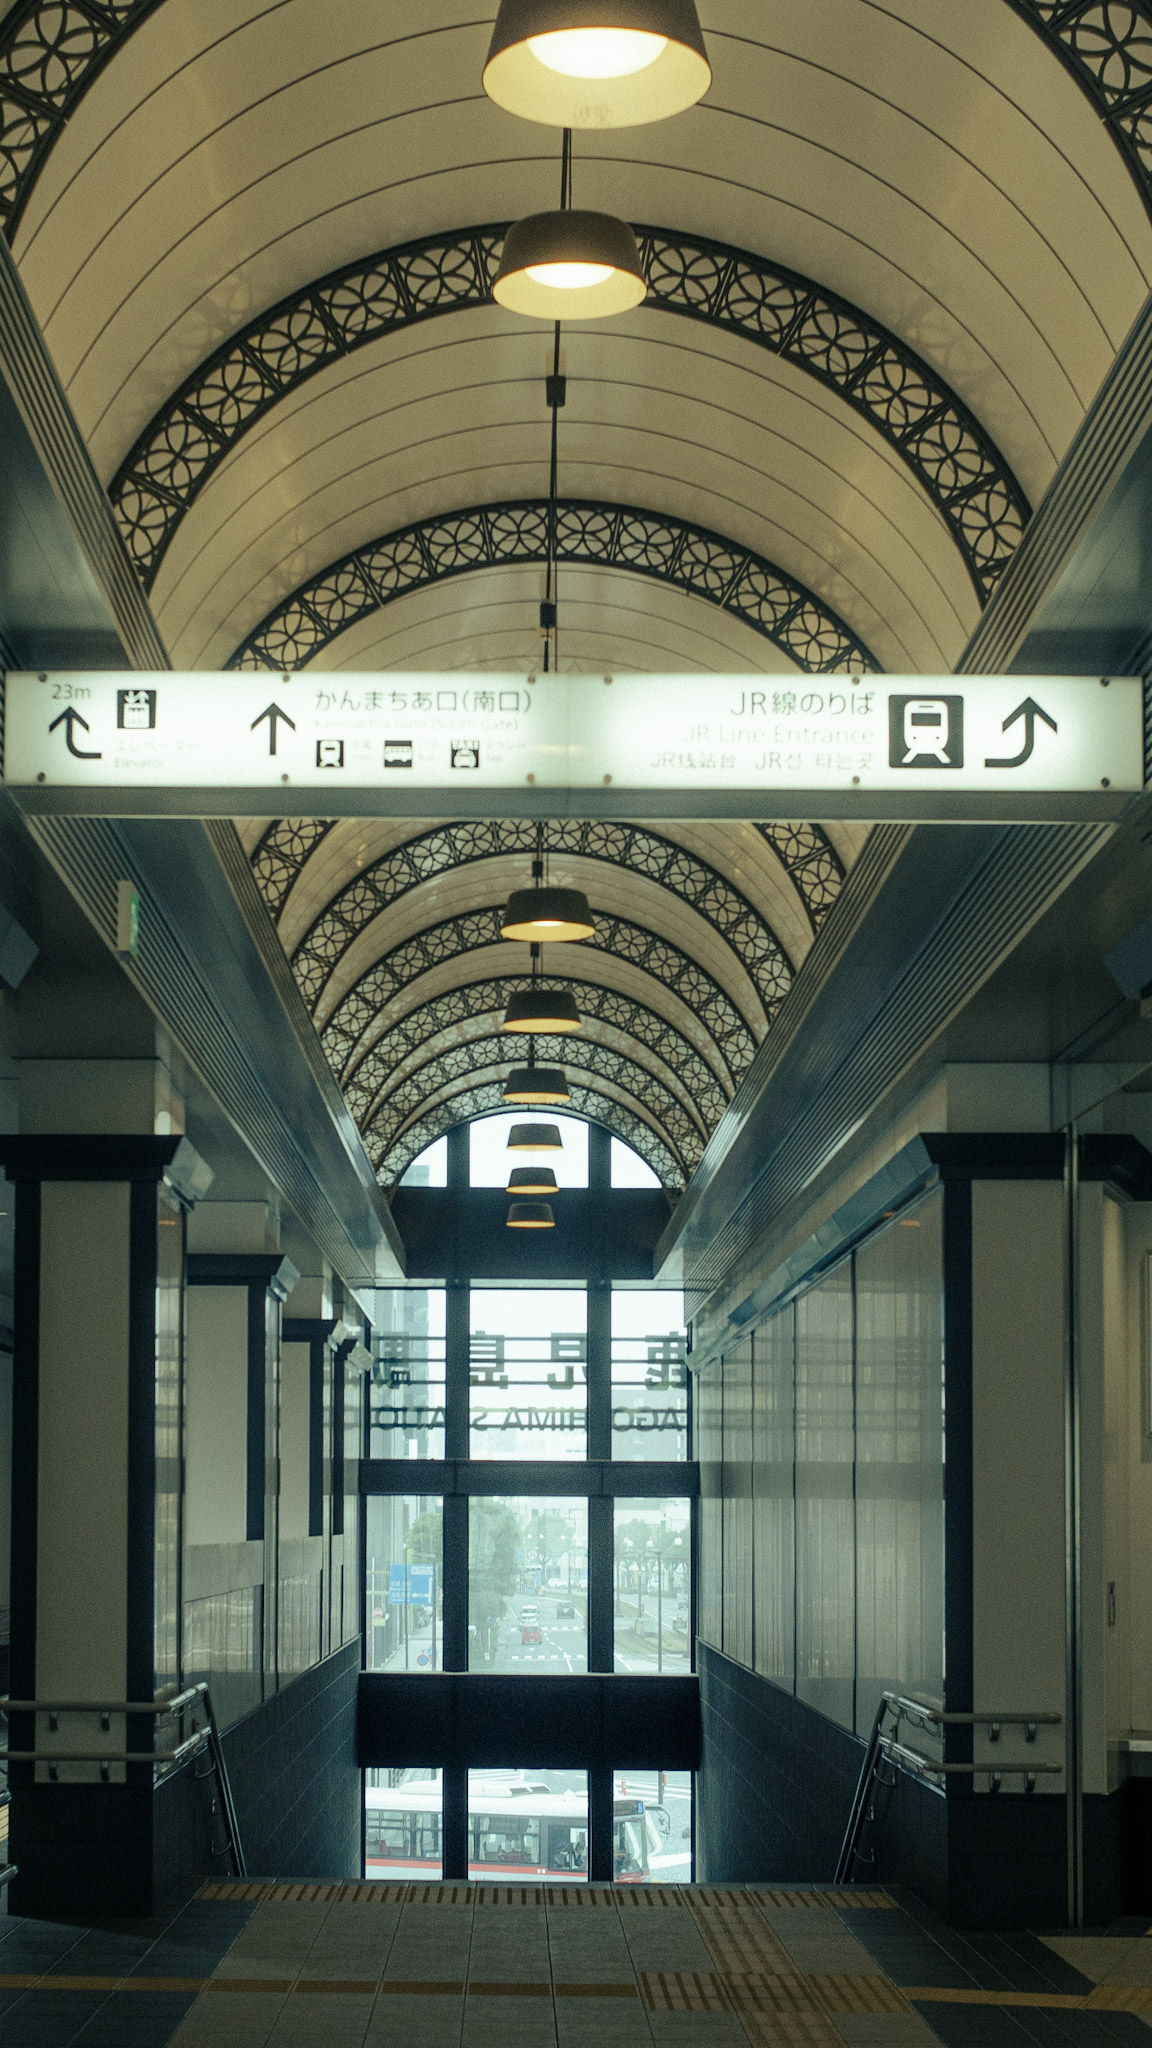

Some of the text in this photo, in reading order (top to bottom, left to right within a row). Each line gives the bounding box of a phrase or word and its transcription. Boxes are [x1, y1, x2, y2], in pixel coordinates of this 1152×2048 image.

[53, 684, 91, 700] 23m
[315, 690, 532, 712] かんまちあ口(南口)
[730, 691, 876, 716] JR線のりば
[683, 725, 875, 744] JR Line Entrance
